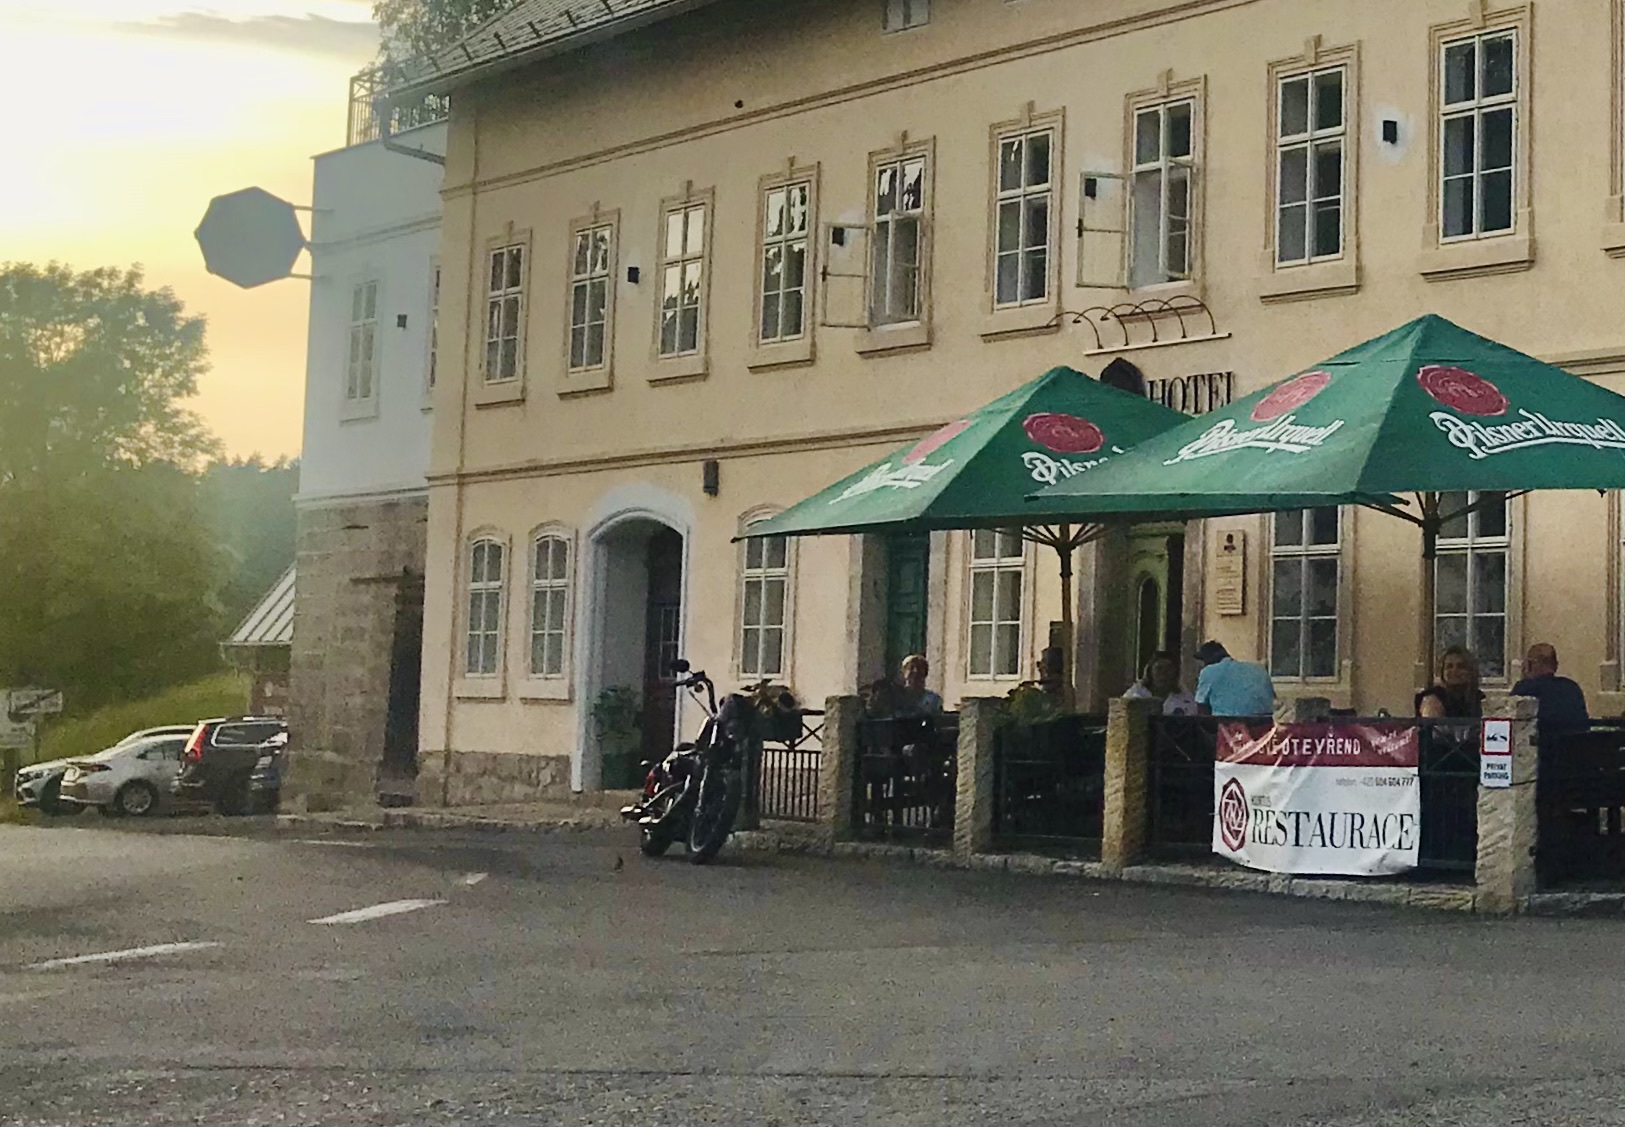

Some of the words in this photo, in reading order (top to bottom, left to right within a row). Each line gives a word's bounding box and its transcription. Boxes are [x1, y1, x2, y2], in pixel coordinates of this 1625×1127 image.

[1429, 411, 1541, 460] Pilsner
[1282, 732, 1362, 756] OTEVŘENO
[1252, 808, 1415, 852] RESTAURACE
